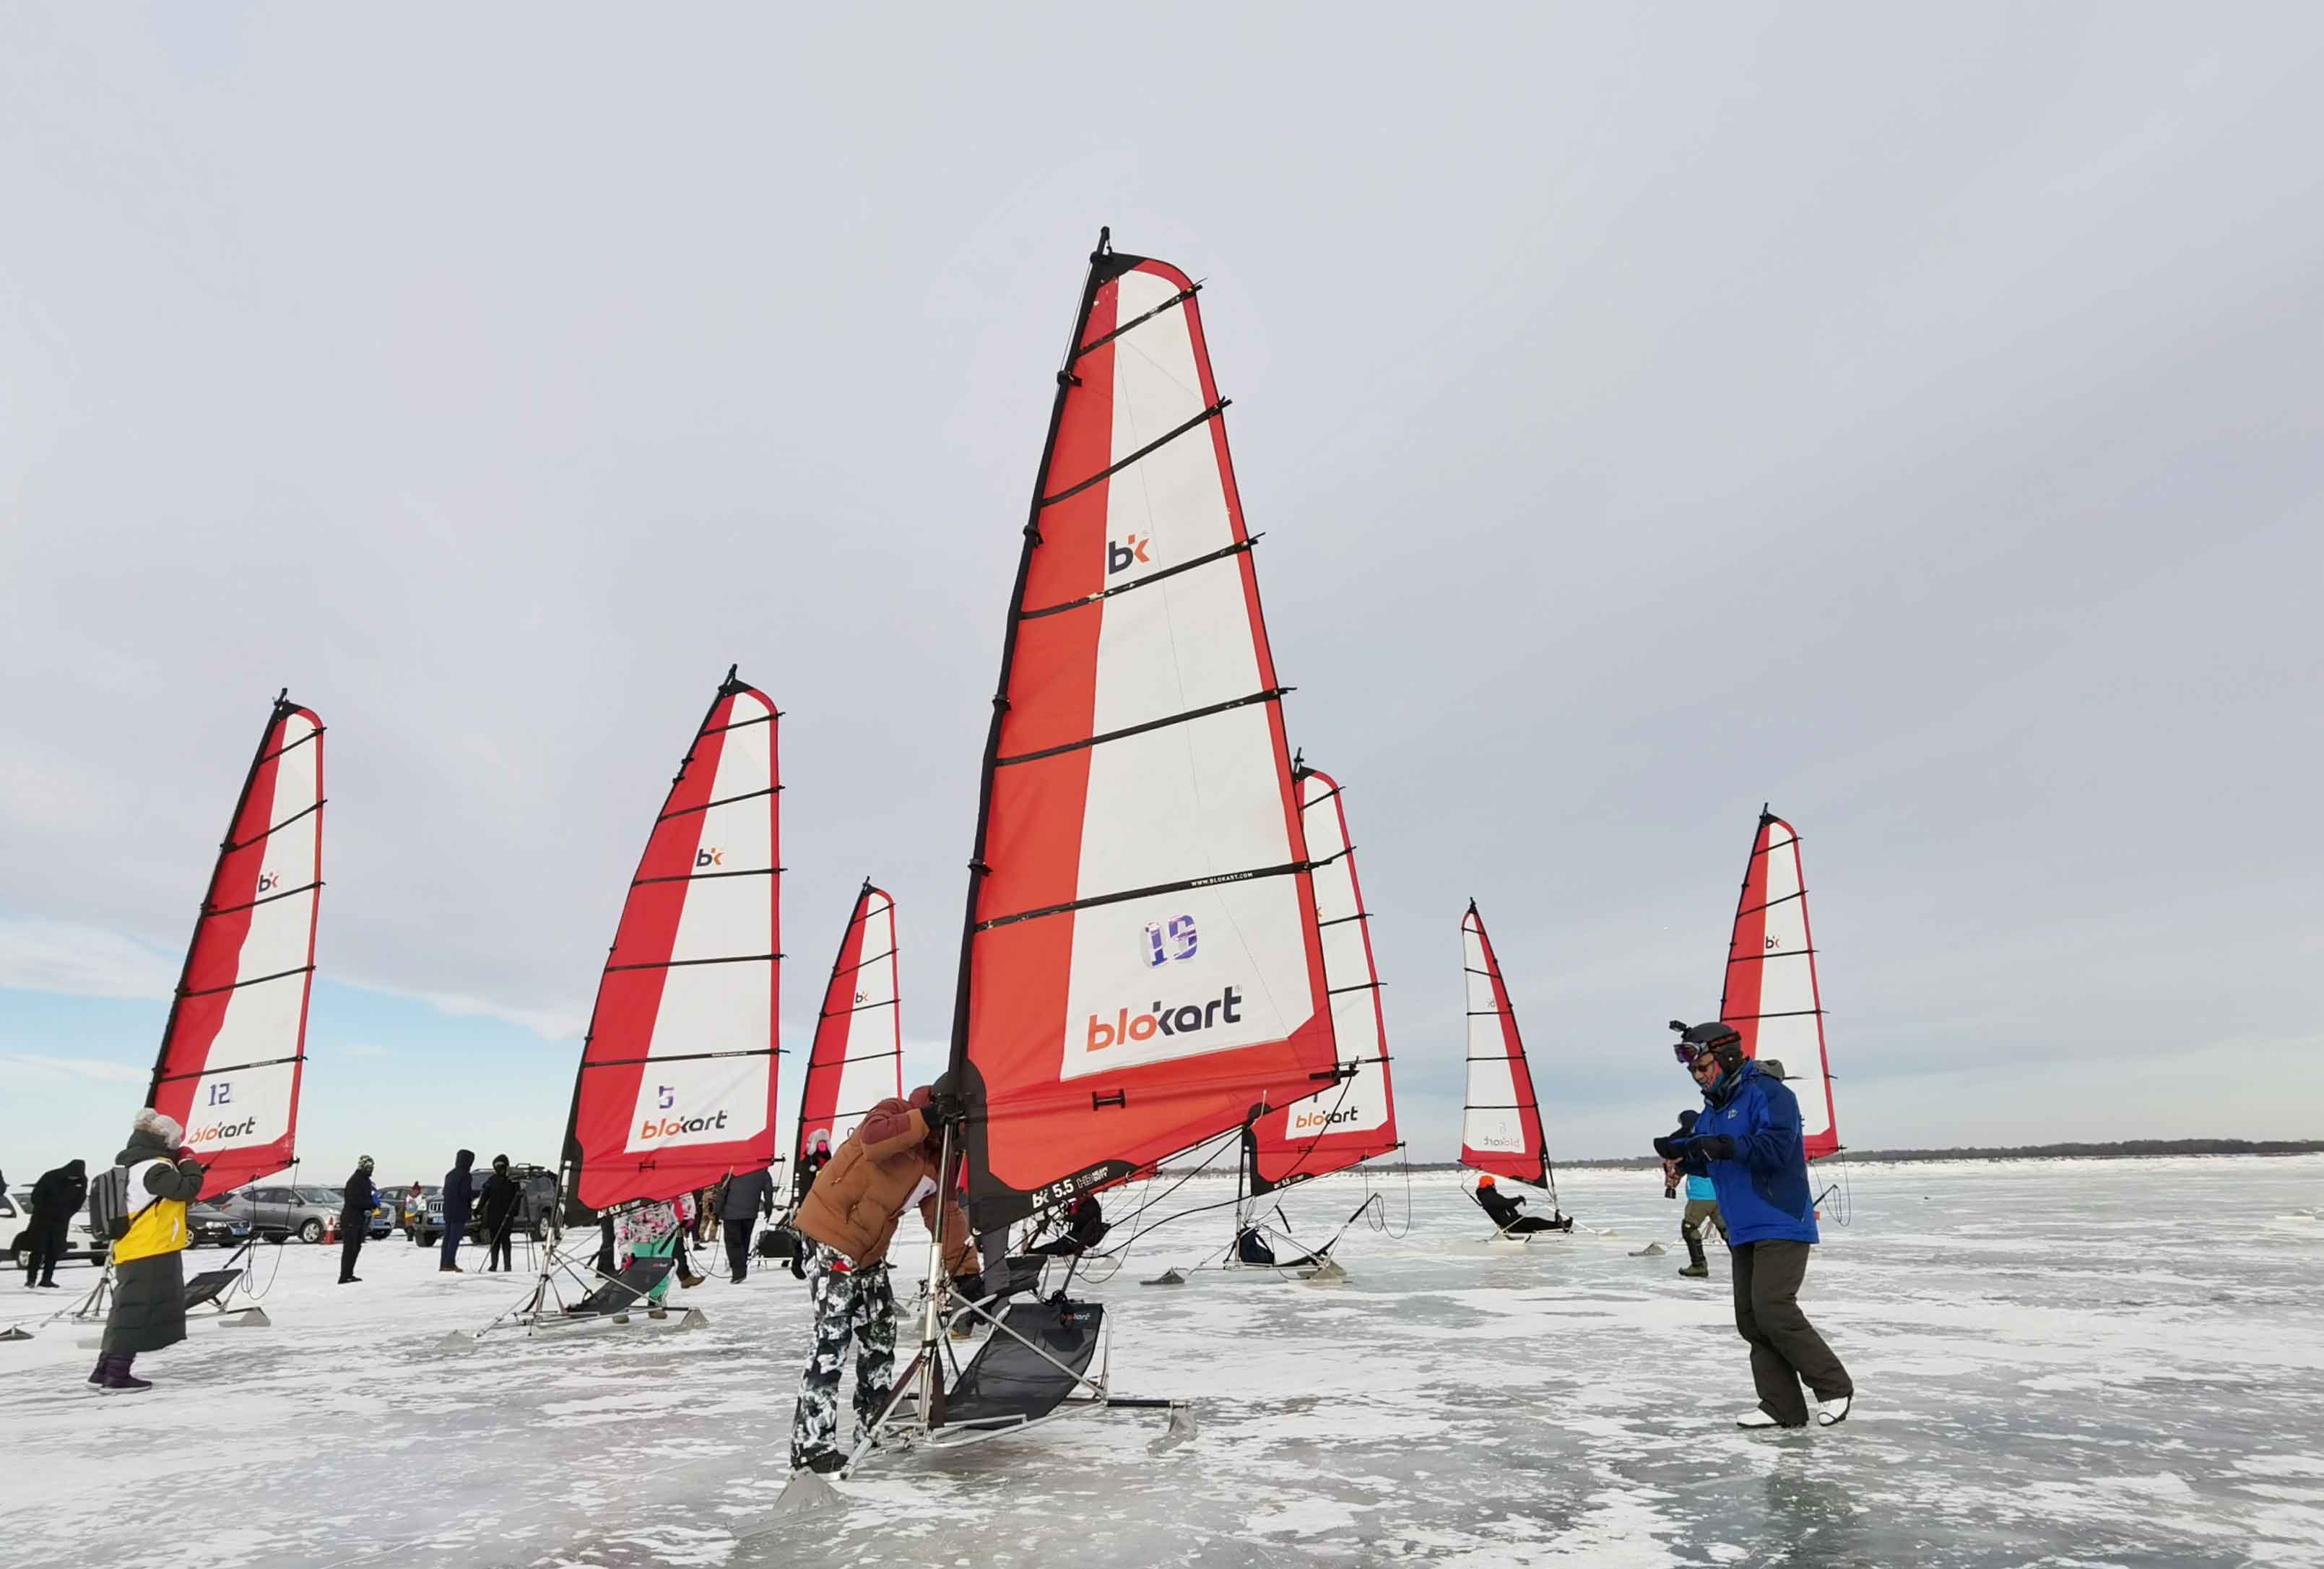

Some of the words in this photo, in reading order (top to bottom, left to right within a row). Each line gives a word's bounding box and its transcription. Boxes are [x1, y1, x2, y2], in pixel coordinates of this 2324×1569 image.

[1108, 533, 1150, 575] bk
[1190, 873, 1254, 886] WWW.BLOKART.COM
[1086, 986, 1241, 1053] blokart
[208, 1083, 230, 1107] 12
[188, 1116, 256, 1144] blokart
[641, 1110, 728, 1140] blokart
[1052, 1179, 1075, 1198] 5.5
